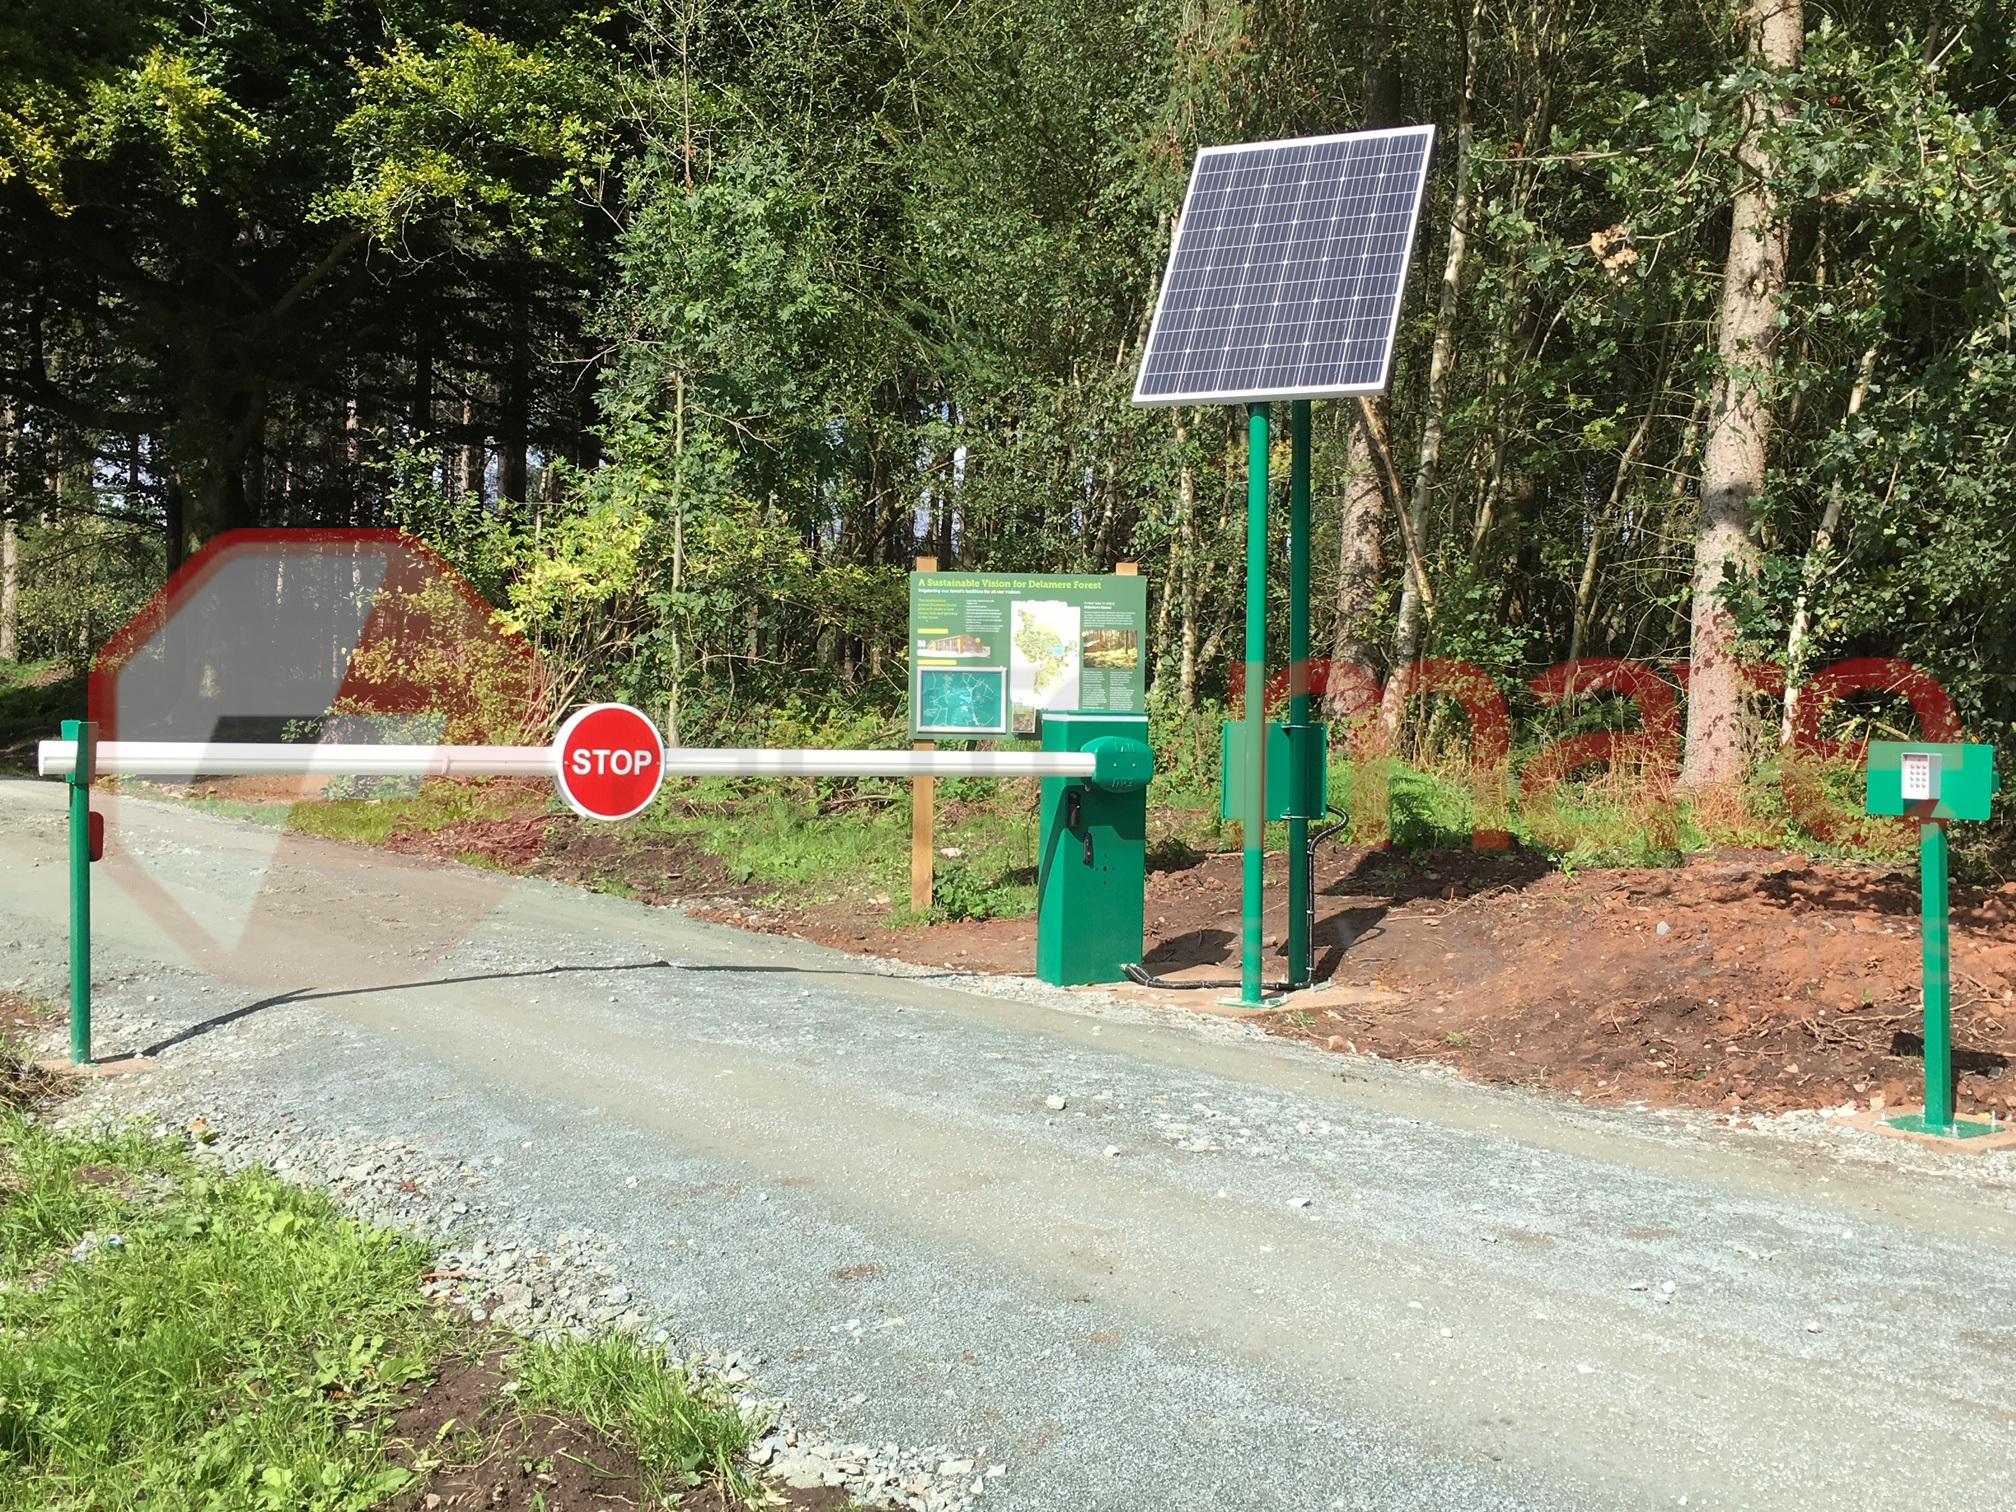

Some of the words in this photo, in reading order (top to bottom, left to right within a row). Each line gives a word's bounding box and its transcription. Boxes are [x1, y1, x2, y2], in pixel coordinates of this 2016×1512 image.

[918, 578, 925, 587] A
[927, 578, 980, 588] Sustainable
[981, 579, 1011, 588] Vision
[1013, 580, 1027, 588] for
[1028, 580, 1072, 589] Delamere
[1073, 580, 1102, 590] Forest
[572, 748, 652, 775] STOP
